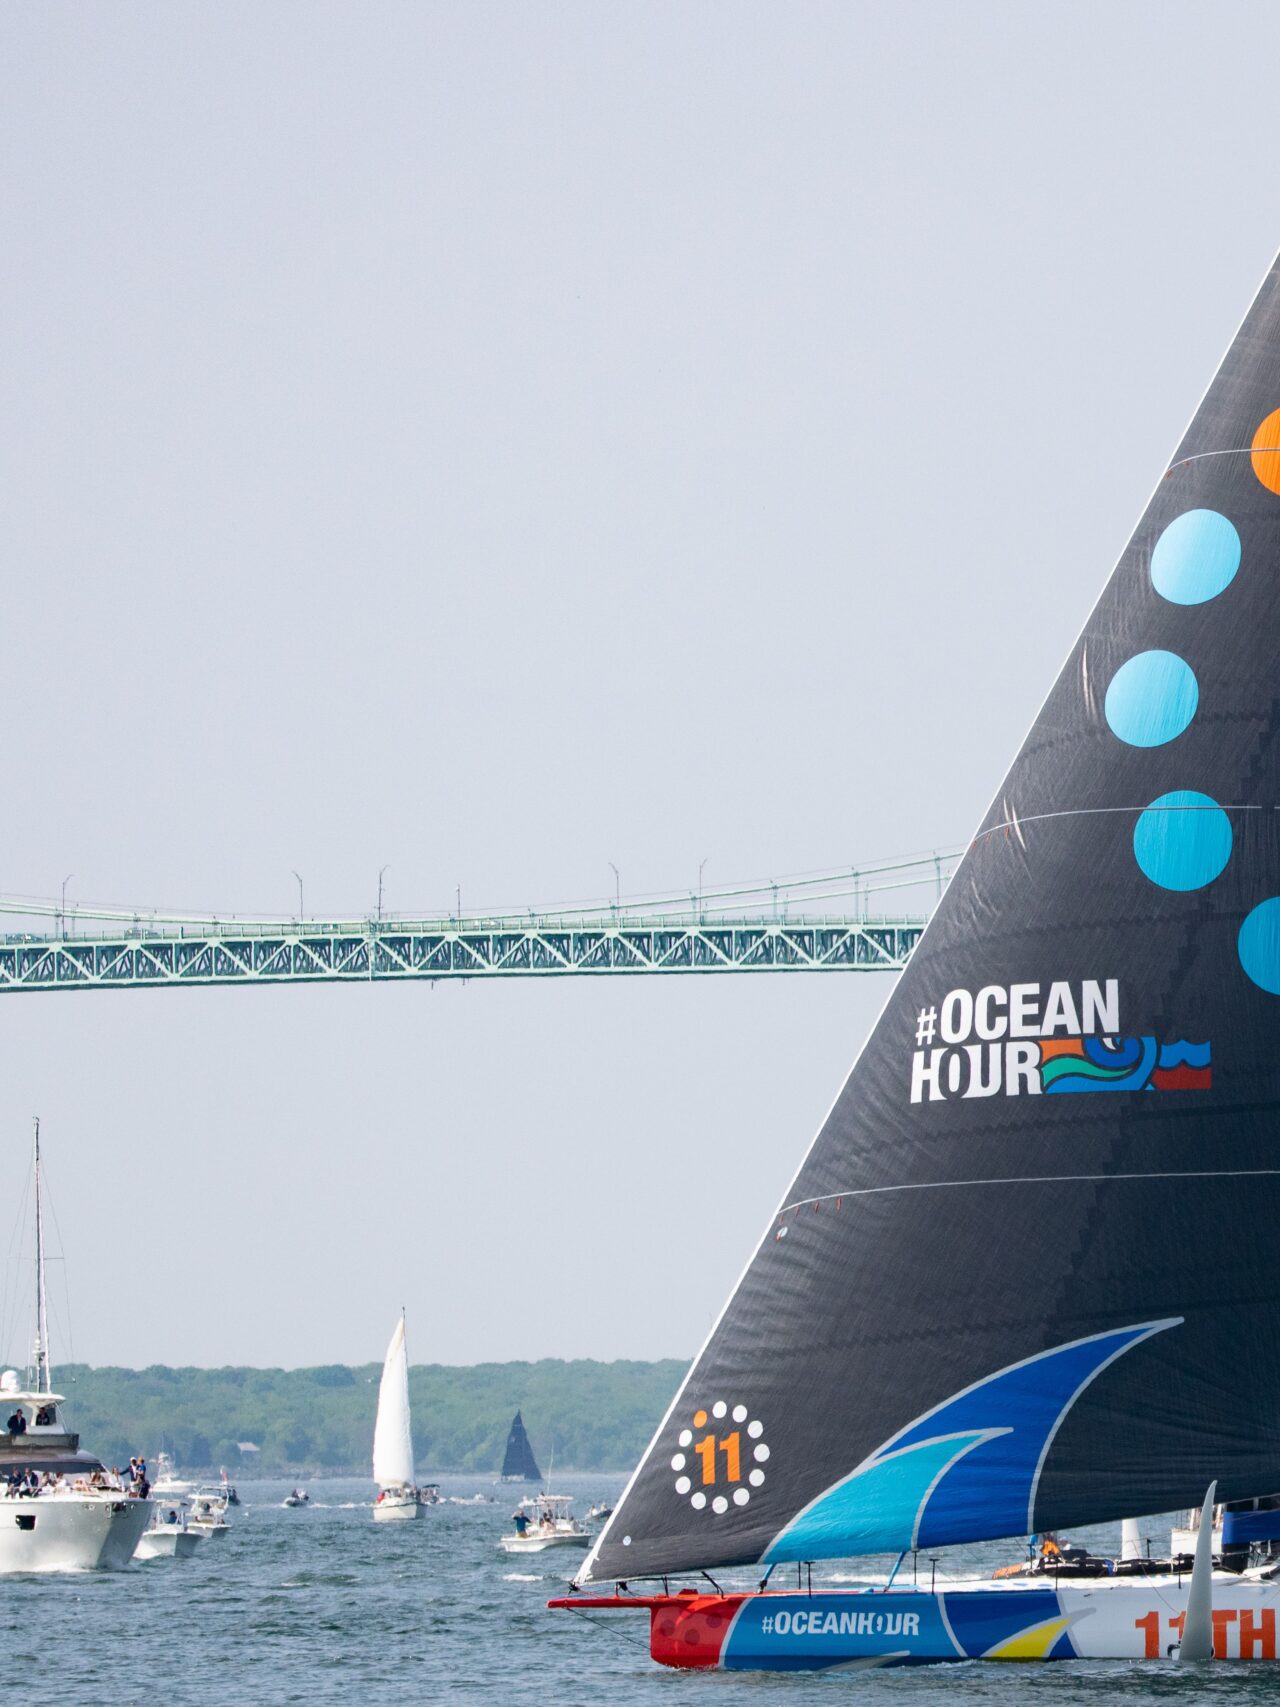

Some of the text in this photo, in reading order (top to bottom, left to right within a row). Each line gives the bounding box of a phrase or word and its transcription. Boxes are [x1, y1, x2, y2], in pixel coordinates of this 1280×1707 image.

[915, 978, 1120, 1046] #OCEAN
[910, 1040, 1044, 1104] HOUR
[695, 1431, 741, 1486] 11
[761, 1611, 920, 1636] #OCEANHOUR
